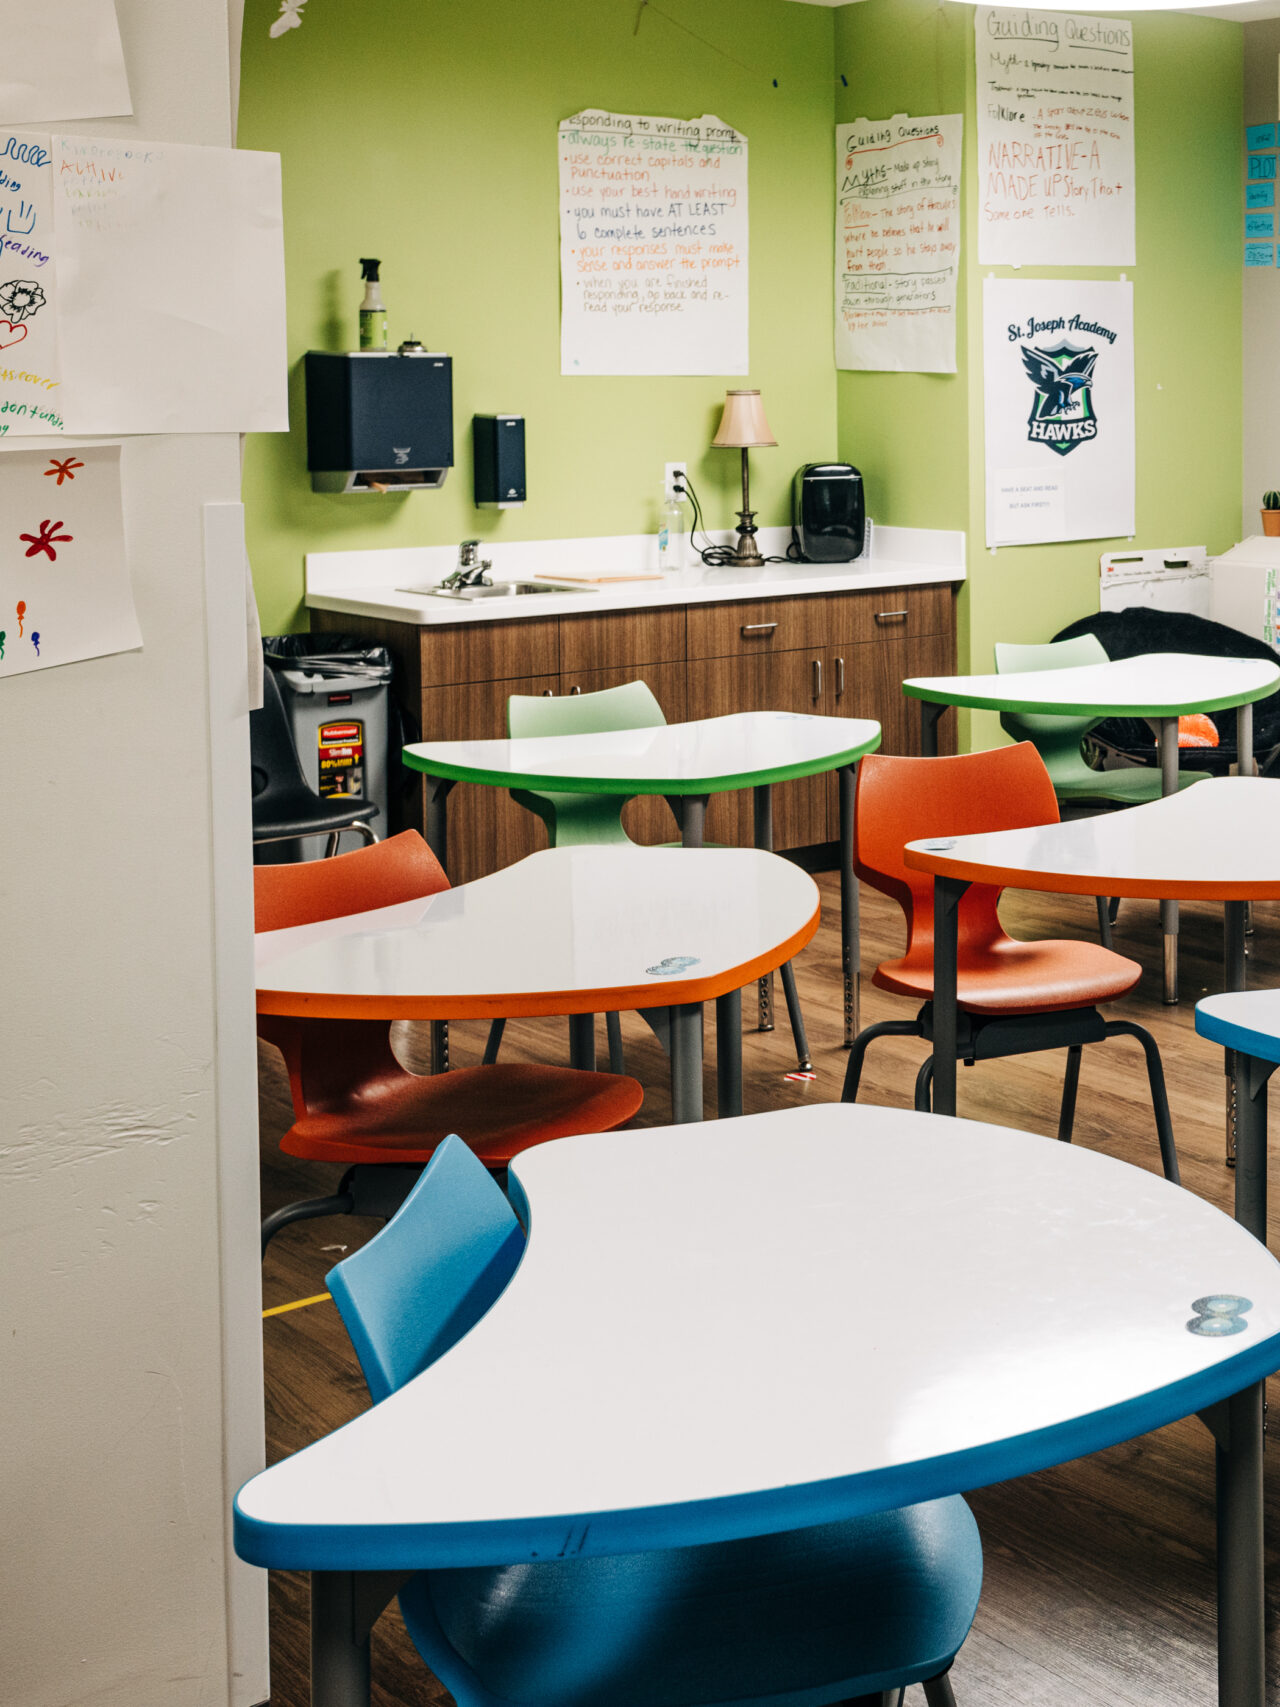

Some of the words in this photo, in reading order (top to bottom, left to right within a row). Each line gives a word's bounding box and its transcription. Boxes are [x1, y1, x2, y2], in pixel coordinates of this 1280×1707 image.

[987, 11, 1059, 52] Guiding
[1065, 18, 1130, 46] Questions
[637, 119, 650, 130] to
[656, 122, 700, 145] writing
[847, 130, 891, 152] Guiding
[898, 125, 939, 137] Questions
[570, 155, 589, 166] use
[597, 156, 642, 167] correct
[648, 155, 694, 170] capitals
[699, 157, 720, 169] and
[572, 187, 593, 197] use
[600, 187, 625, 200] your
[632, 183, 658, 196] best
[987, 172, 1038, 200] MADE
[574, 208, 594, 219] you
[601, 207, 631, 218] must
[637, 205, 663, 217] have
[668, 204, 683, 215] AT
[689, 203, 727, 215] LEAST
[577, 226, 586, 240] 6
[594, 226, 645, 240] complete
[652, 223, 716, 237] sentences
[0, 234, 49, 267] eading
[579, 246, 604, 257] your
[611, 244, 667, 257] responses
[675, 245, 702, 254] must
[708, 243, 734, 254] make
[577, 260, 608, 272] sense
[613, 258, 631, 270] and
[637, 259, 674, 270] answer
[682, 258, 697, 269] the
[702, 256, 740, 270] prompt
[1007, 324, 1025, 342] St.
[1027, 316, 1065, 340] Joseph
[1068, 314, 1117, 344] Academy
[1031, 420, 1096, 441] HAWKS
